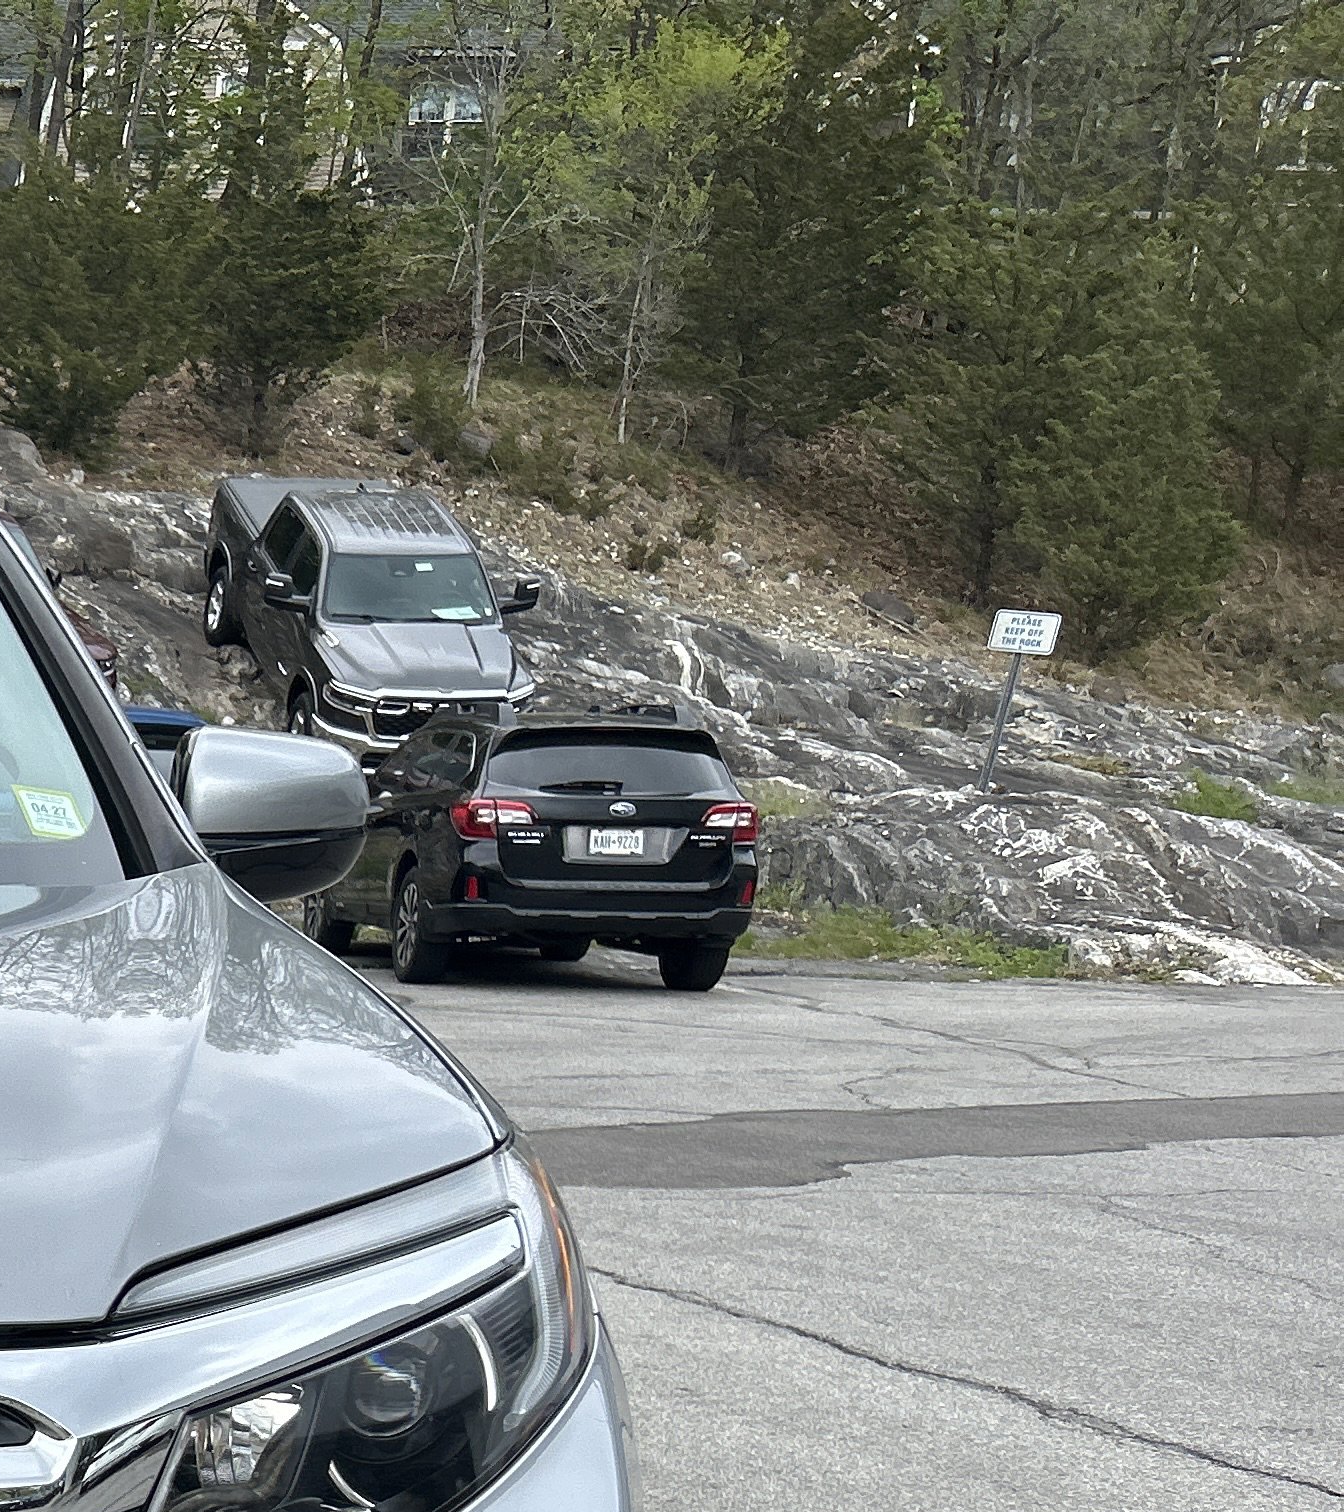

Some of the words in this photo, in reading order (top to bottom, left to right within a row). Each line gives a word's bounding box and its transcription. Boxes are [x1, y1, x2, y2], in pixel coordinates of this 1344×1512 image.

[1011, 617, 1042, 627] PLEASE
[1004, 627, 1025, 635] KEEP
[1027, 629, 1044, 637] OFF
[1001, 636, 1017, 645] THE
[1019, 638, 1042, 647] ROCK
